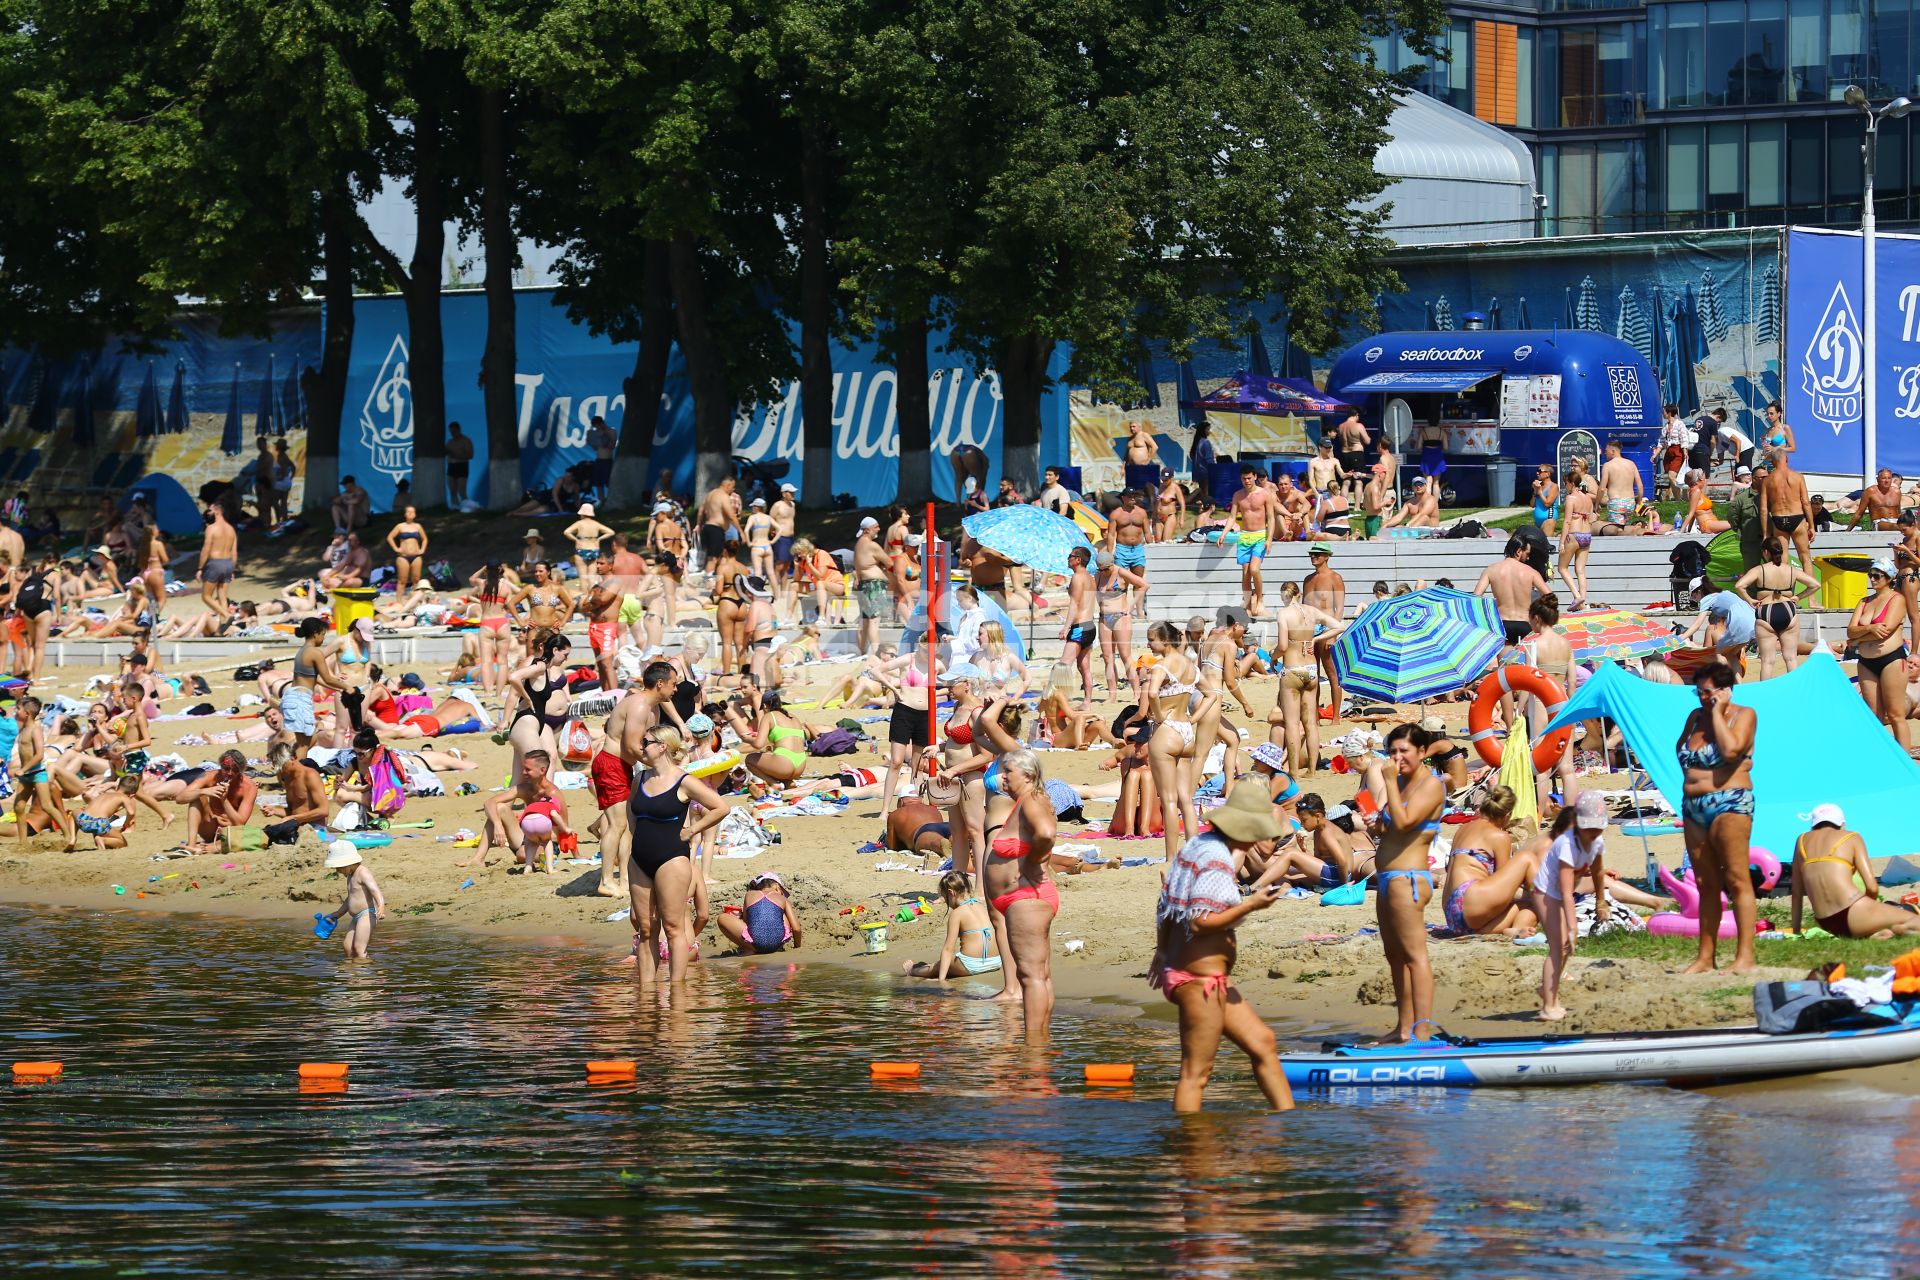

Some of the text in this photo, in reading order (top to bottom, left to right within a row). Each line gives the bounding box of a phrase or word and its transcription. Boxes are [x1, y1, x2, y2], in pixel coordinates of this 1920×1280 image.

[1399, 347, 1485, 361] seafoodbox
[1610, 368, 1636, 383] SEA
[1613, 382, 1638, 392] FOOD
[1614, 391, 1640, 406] BOX
[1818, 394, 1857, 418] МГО
[1308, 1065, 1446, 1083] MOLOKAI
